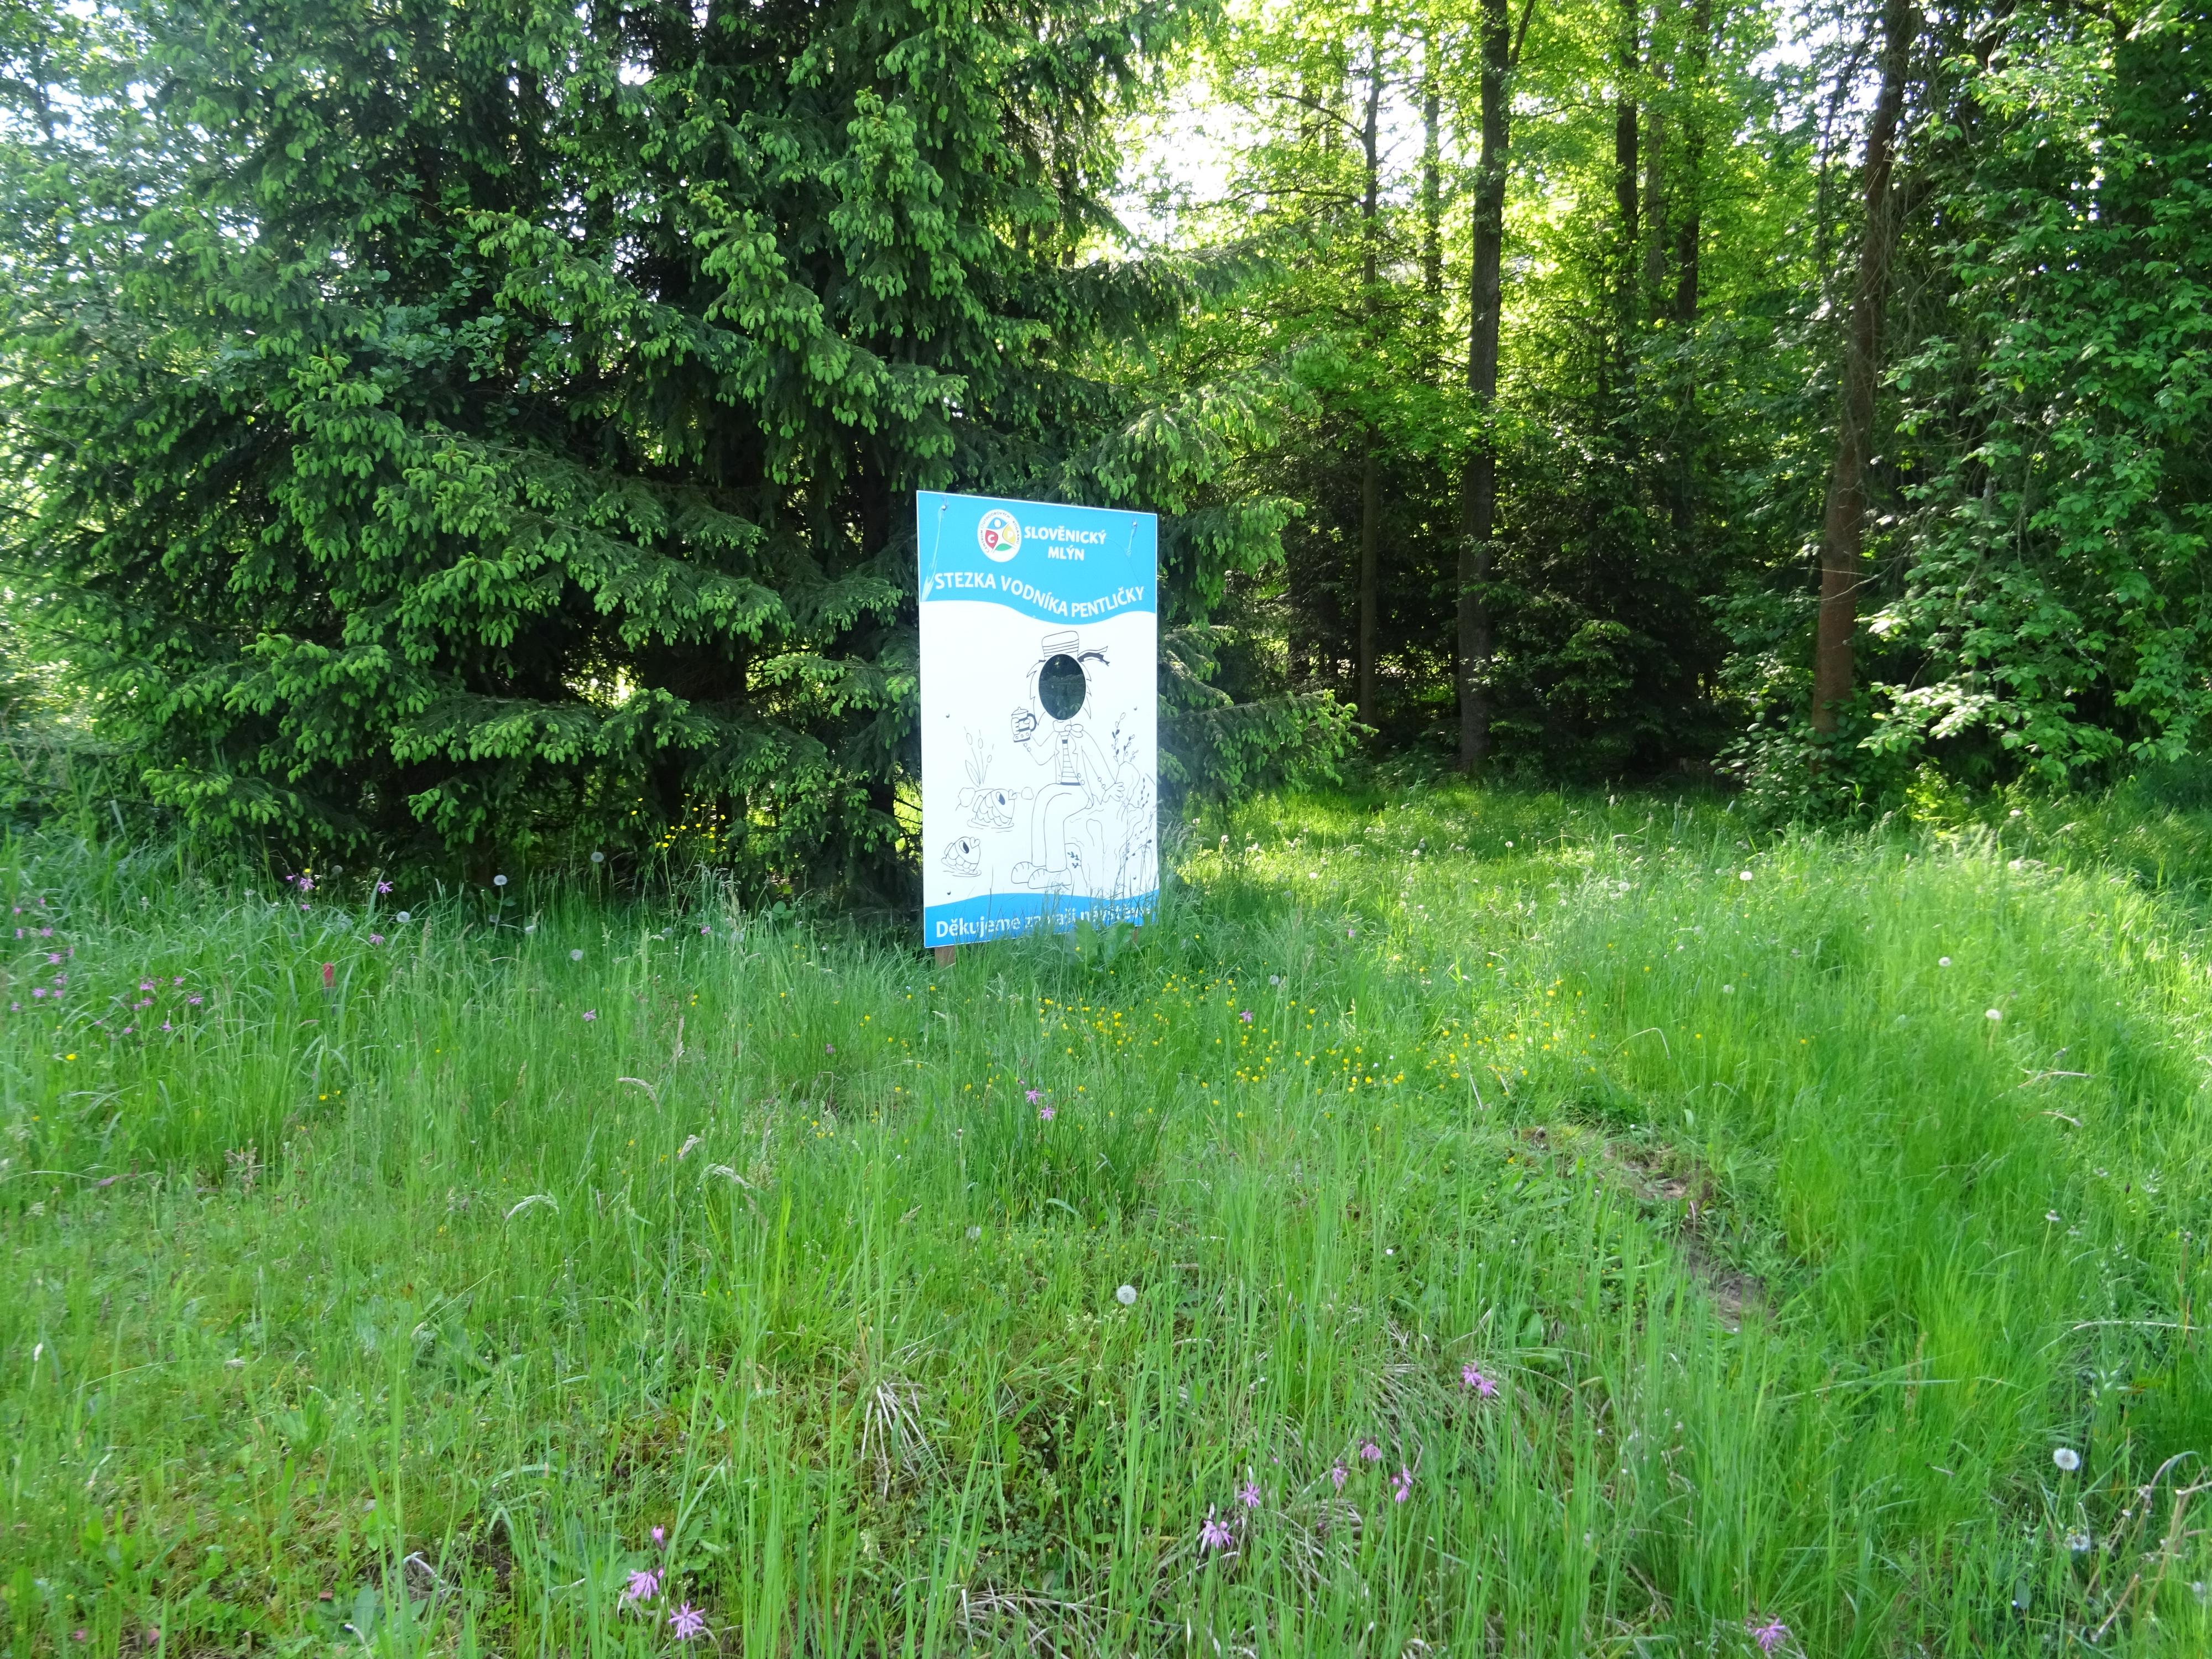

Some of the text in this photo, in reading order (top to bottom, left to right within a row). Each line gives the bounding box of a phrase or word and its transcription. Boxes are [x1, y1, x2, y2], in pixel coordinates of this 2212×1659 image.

[1024, 525, 1107, 545] SLOVĚNICKÝ
[1048, 545, 1084, 561] MLÝN
[935, 572, 1144, 617] STEZKA VODNÍKA PENTLIČKY
[936, 916, 1021, 938] Děkujeme
